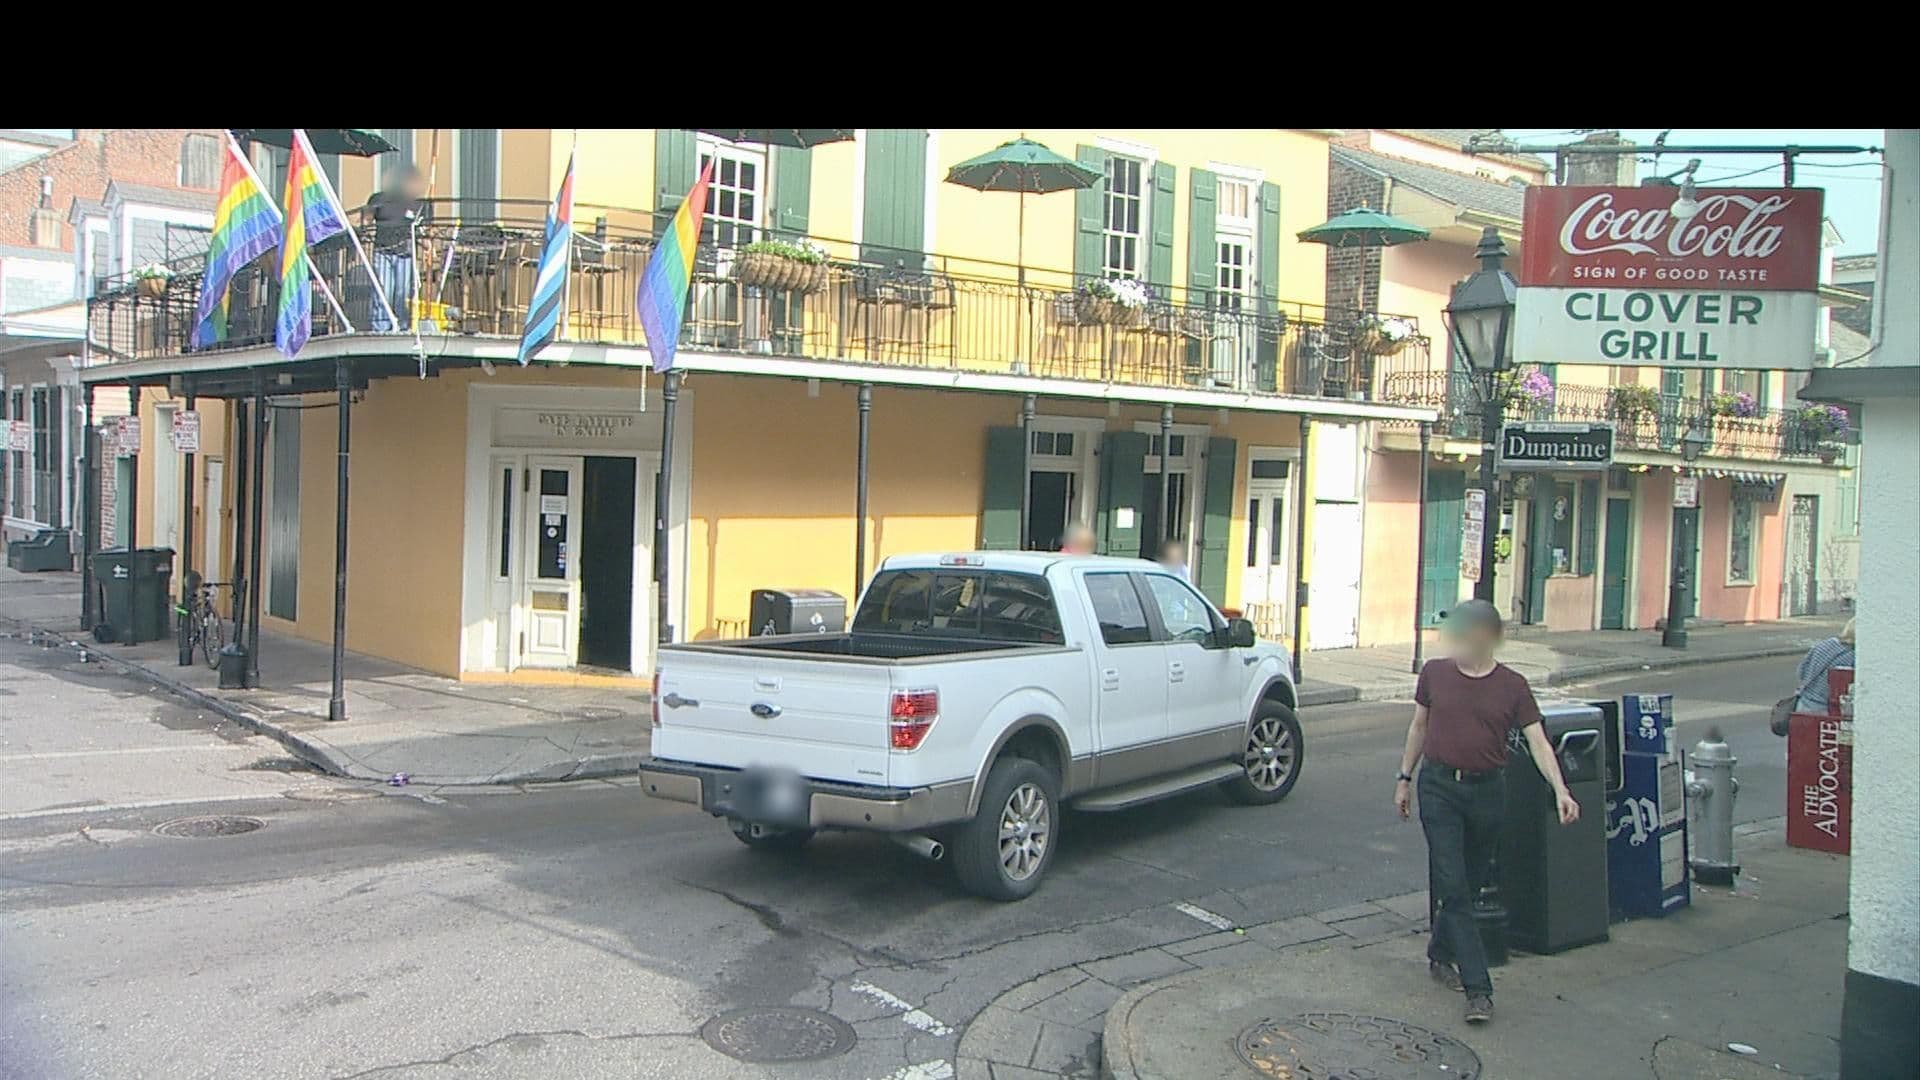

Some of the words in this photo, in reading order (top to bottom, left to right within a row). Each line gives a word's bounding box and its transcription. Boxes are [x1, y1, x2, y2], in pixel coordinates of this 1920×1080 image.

[1560, 193, 1667, 256] Coca
[1668, 194, 1794, 258] Cola
[1573, 266, 1616, 279] SIGN
[1624, 267, 1647, 279] OF
[1656, 268, 1709, 280] GOOD
[1719, 269, 1768, 281] TASTE
[1565, 292, 1763, 325] CLOVER
[1600, 329, 1718, 362] GRILL
[1508, 435, 1607, 458] Dumaine
[1813, 720, 1840, 838] ADVOCATE
[1803, 784, 1820, 817] THE
